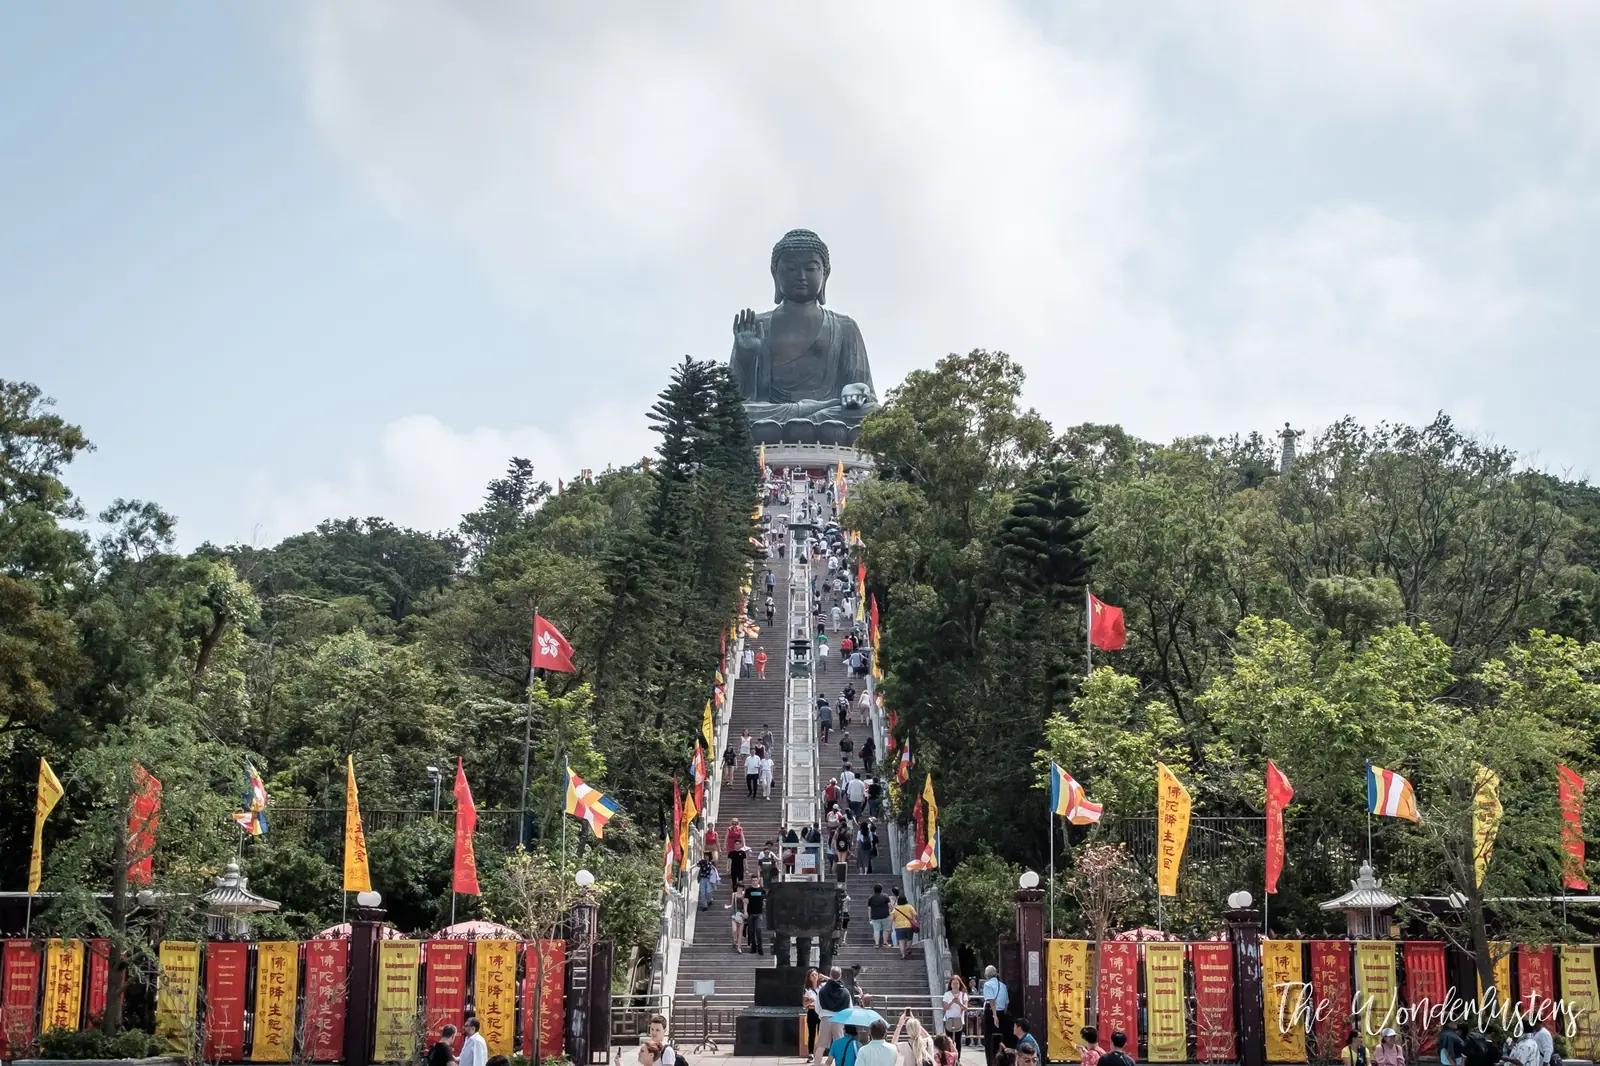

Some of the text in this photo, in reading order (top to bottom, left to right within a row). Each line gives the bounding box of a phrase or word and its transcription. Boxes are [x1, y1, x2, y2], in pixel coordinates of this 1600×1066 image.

[54, 951, 74, 1028] 佛陀降生紀
[265, 956, 287, 1046] 佛陀降生紀念
[317, 954, 336, 1045] 佛陀降生紀念
[486, 954, 504, 1045] 佛陀降生紀念
[1058, 954, 1075, 1042] 佛陀降生紀念
[1108, 957, 1126, 1032] 佛陀降生紀
